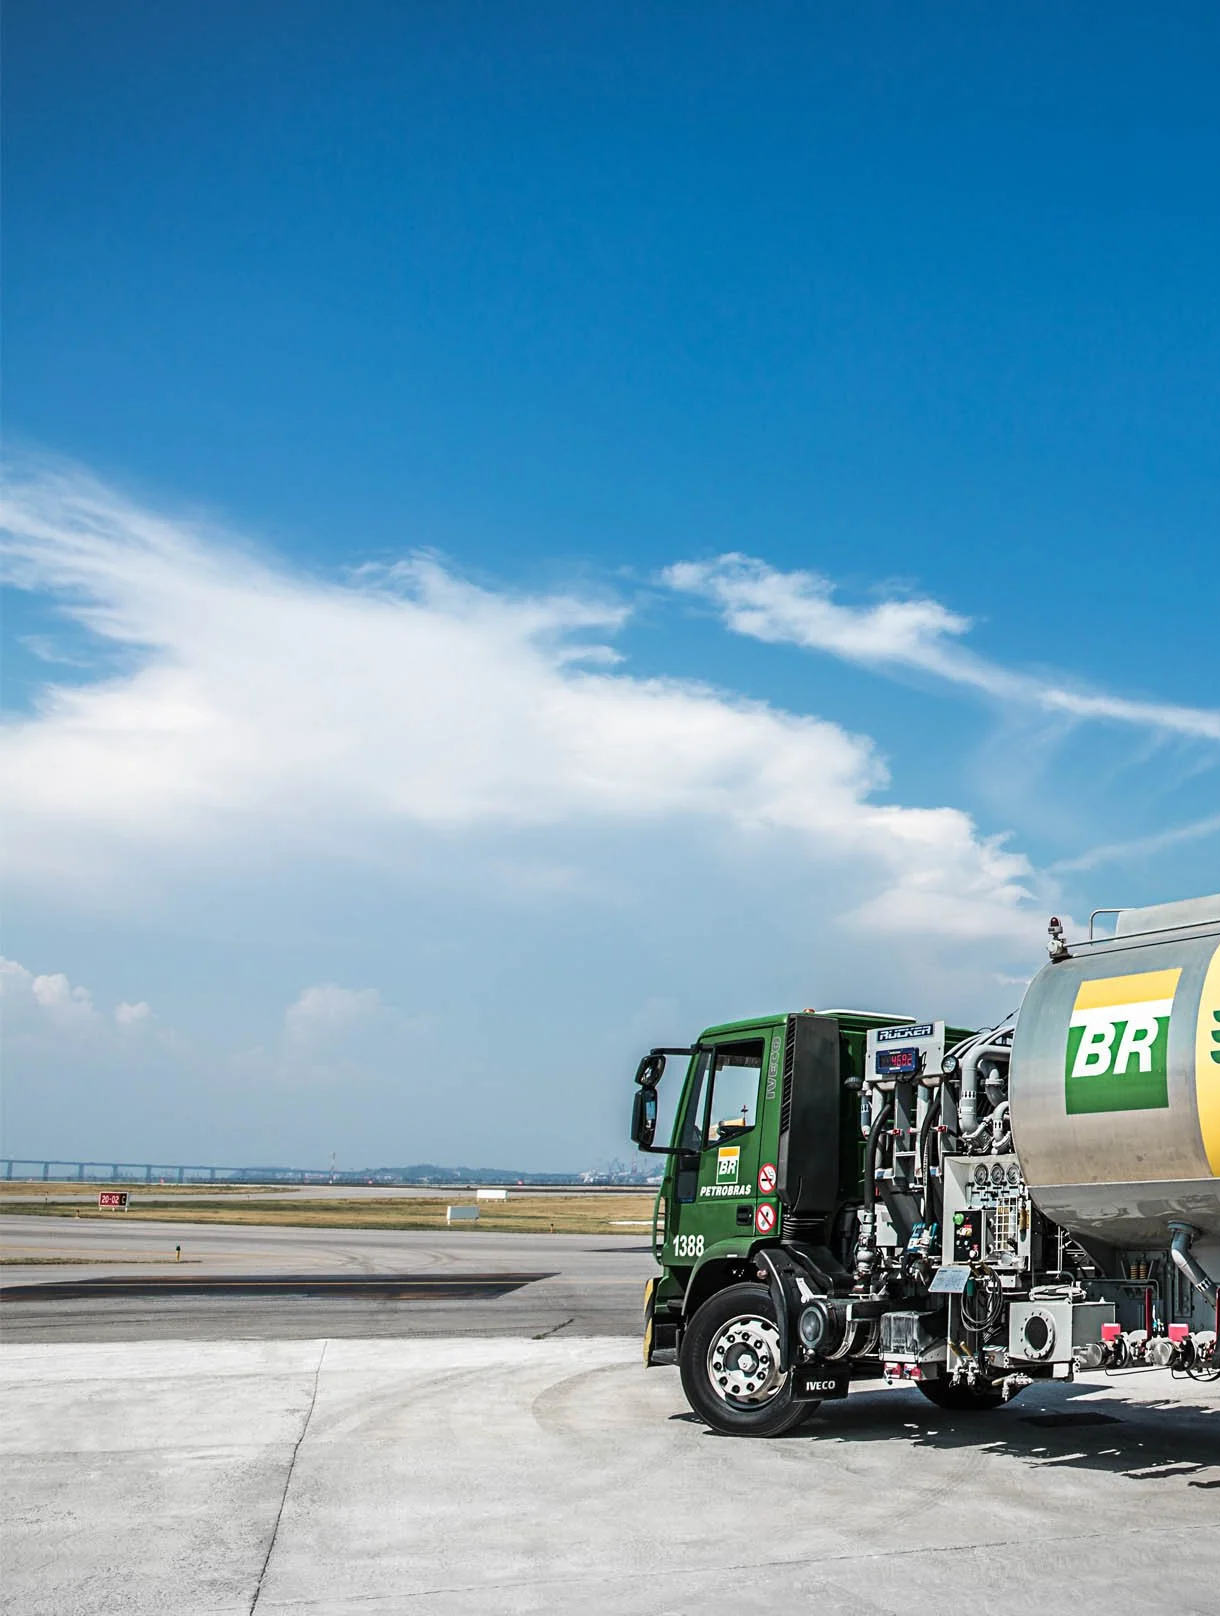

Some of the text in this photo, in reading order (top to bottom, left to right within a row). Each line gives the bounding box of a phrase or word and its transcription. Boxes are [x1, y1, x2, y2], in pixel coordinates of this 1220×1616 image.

[1071, 1011, 1160, 1078] BR
[766, 1036, 781, 1100] IVECO
[718, 1159, 737, 1175] BR
[700, 1184, 752, 1197] PETROBRAS
[101, 1194, 120, 1204] 20-02
[672, 1234, 705, 1257] 1388
[806, 1380, 836, 1391] IVECO
